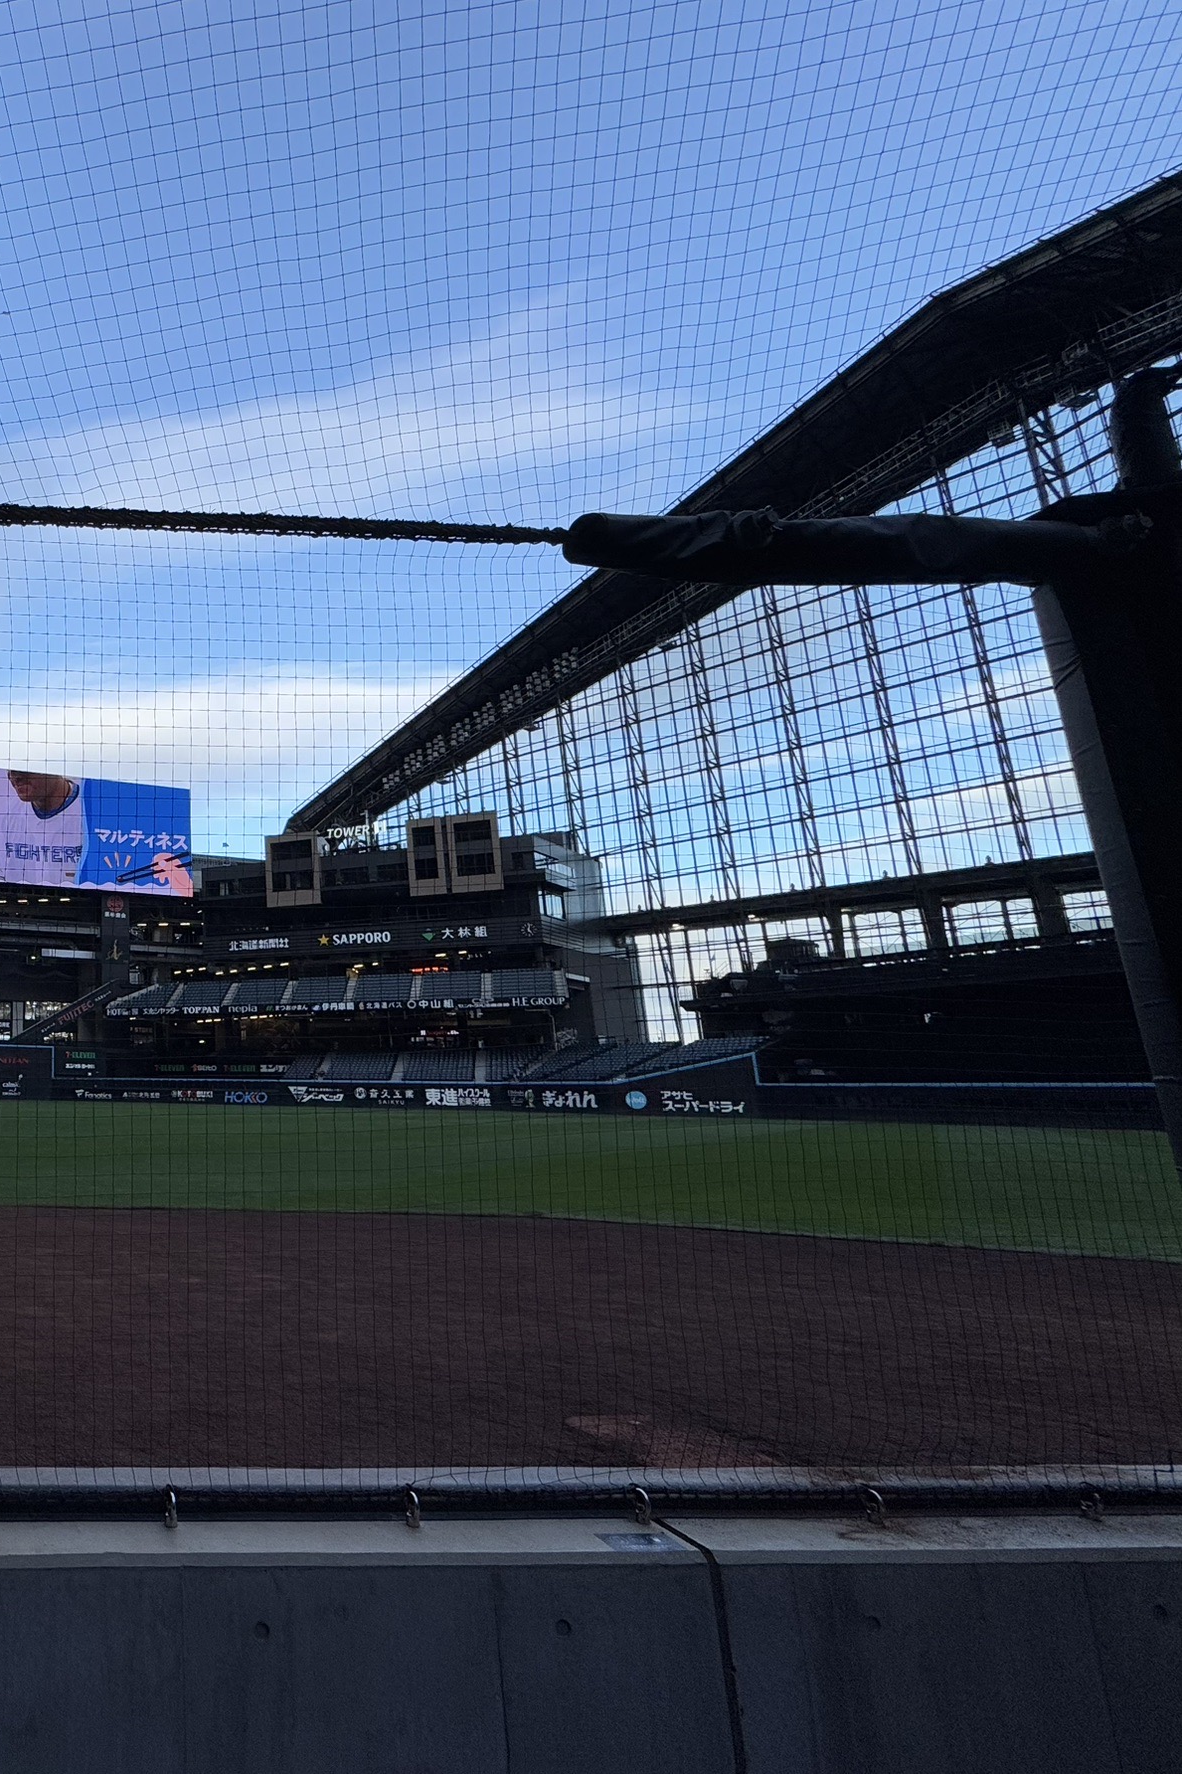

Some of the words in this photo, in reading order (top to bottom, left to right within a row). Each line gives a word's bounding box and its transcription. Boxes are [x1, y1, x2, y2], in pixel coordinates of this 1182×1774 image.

[326, 825, 370, 839] TOWER
[95, 828, 189, 850] マルティネス
[332, 931, 391, 945] SAPPORO
[441, 926, 488, 940] 大林組
[229, 938, 289, 951] 北海道新聞社
[418, 999, 454, 1009] 中山組
[530, 997, 565, 1006] GROUP
[58, 1000, 94, 1025] FUJITEC
[182, 1006, 220, 1014] TOPPAN
[228, 1004, 258, 1013] nepia
[425, 1088, 458, 1106] 東進
[458, 1088, 490, 1098] ハイスクール
[542, 1090, 598, 1109] ぎょれん
[660, 1090, 693, 1100] アサヒ
[662, 1101, 745, 1113] スーパードライ
